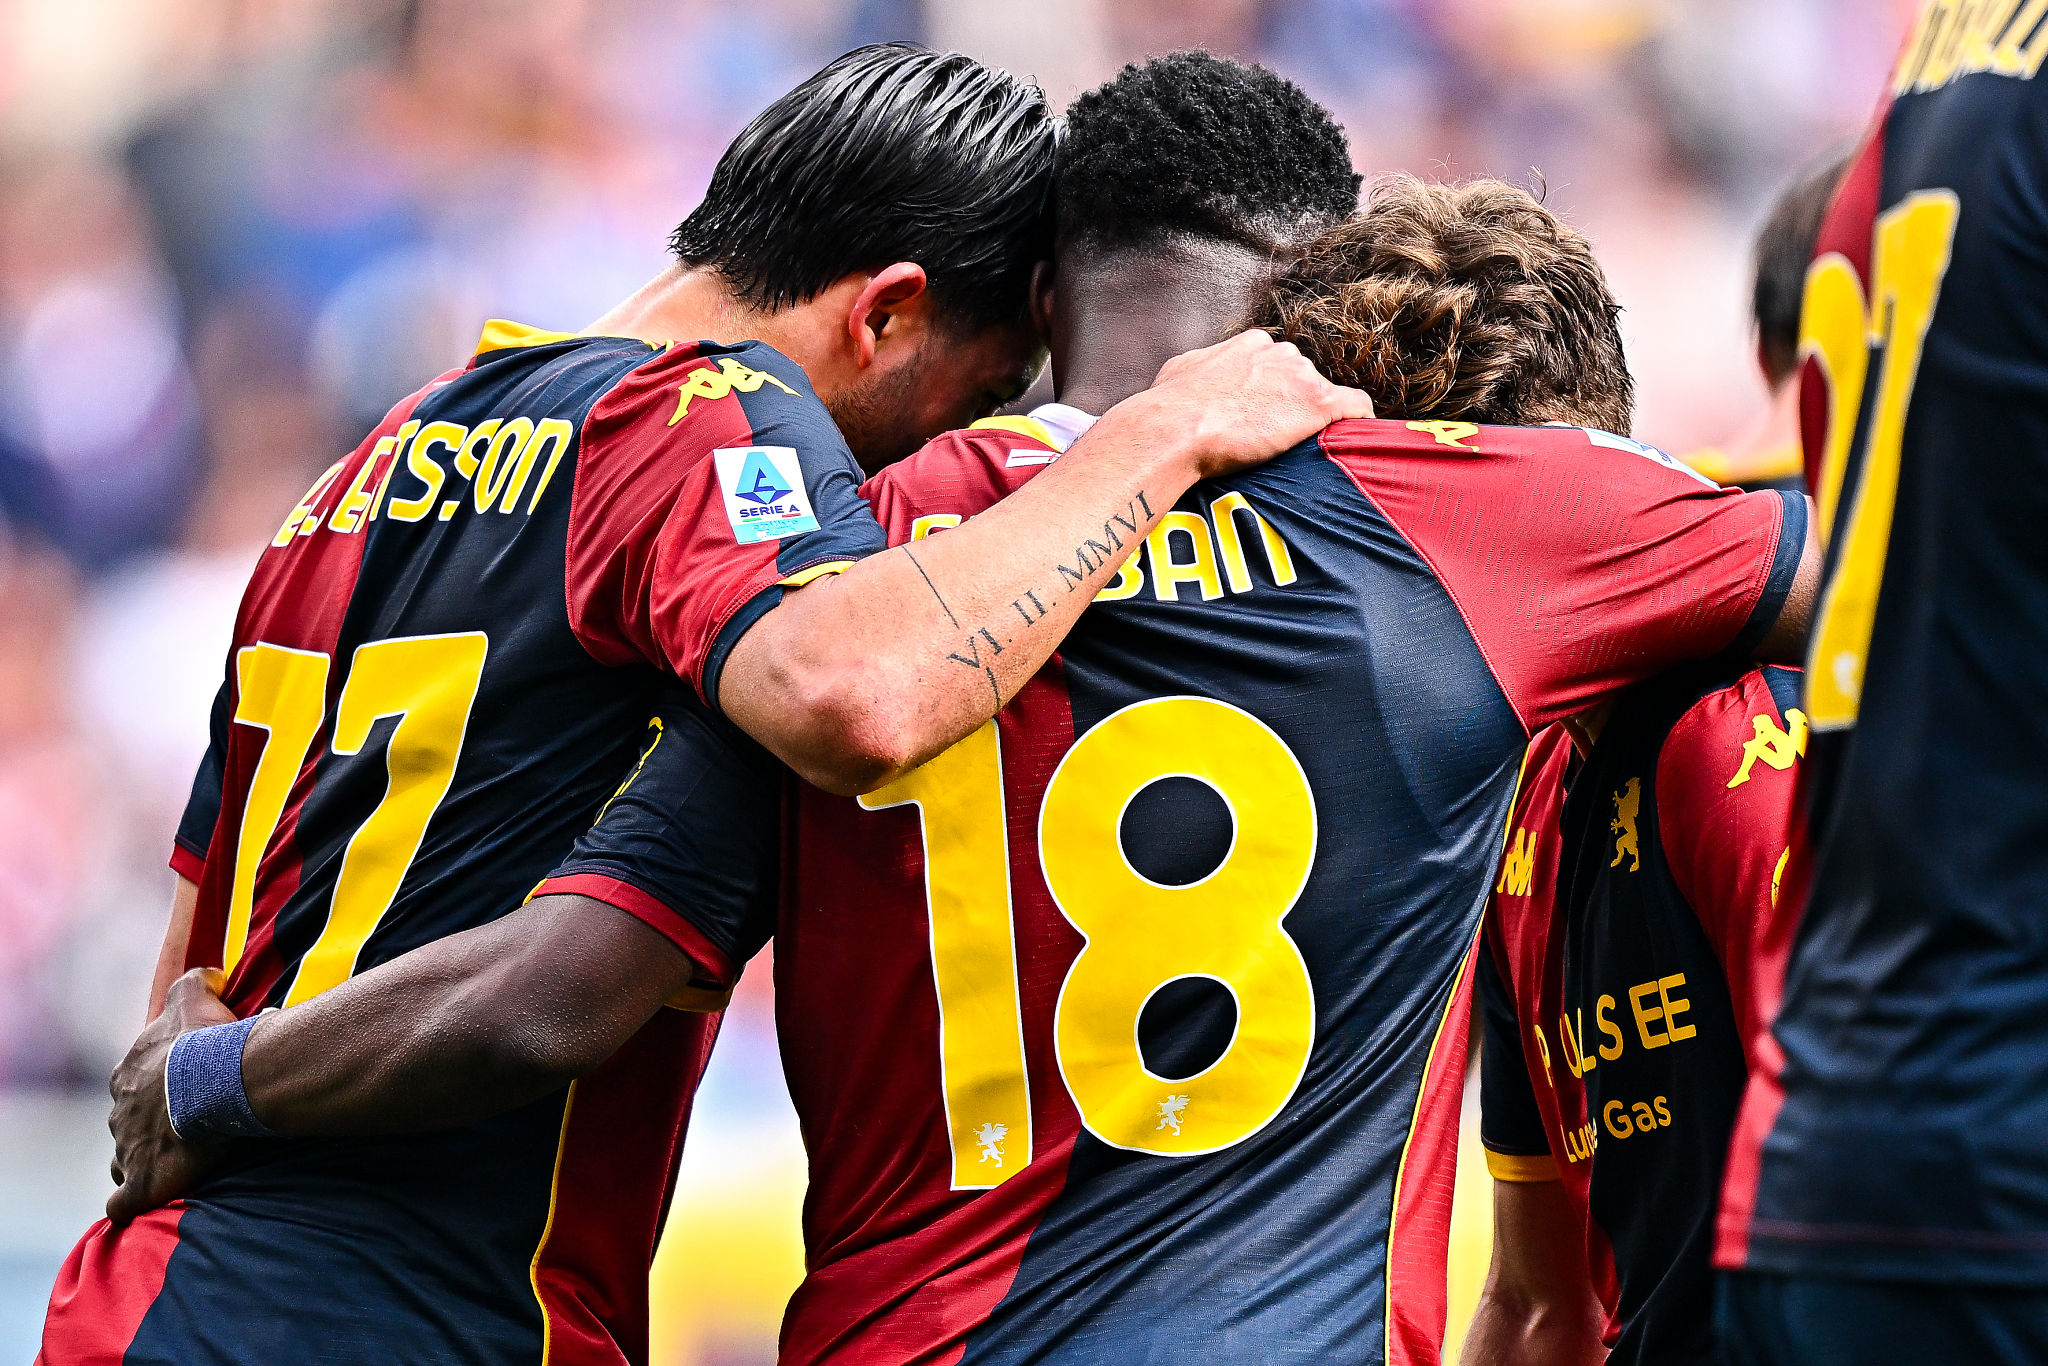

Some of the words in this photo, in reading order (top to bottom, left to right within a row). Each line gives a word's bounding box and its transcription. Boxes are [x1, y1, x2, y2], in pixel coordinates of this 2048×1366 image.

[739, 505, 785, 518] SERIE
[788, 504, 801, 513] A
[1057, 490, 1155, 593] MMVI
[856, 695, 1318, 1192] 18
[1603, 1095, 1672, 1140] Gas
